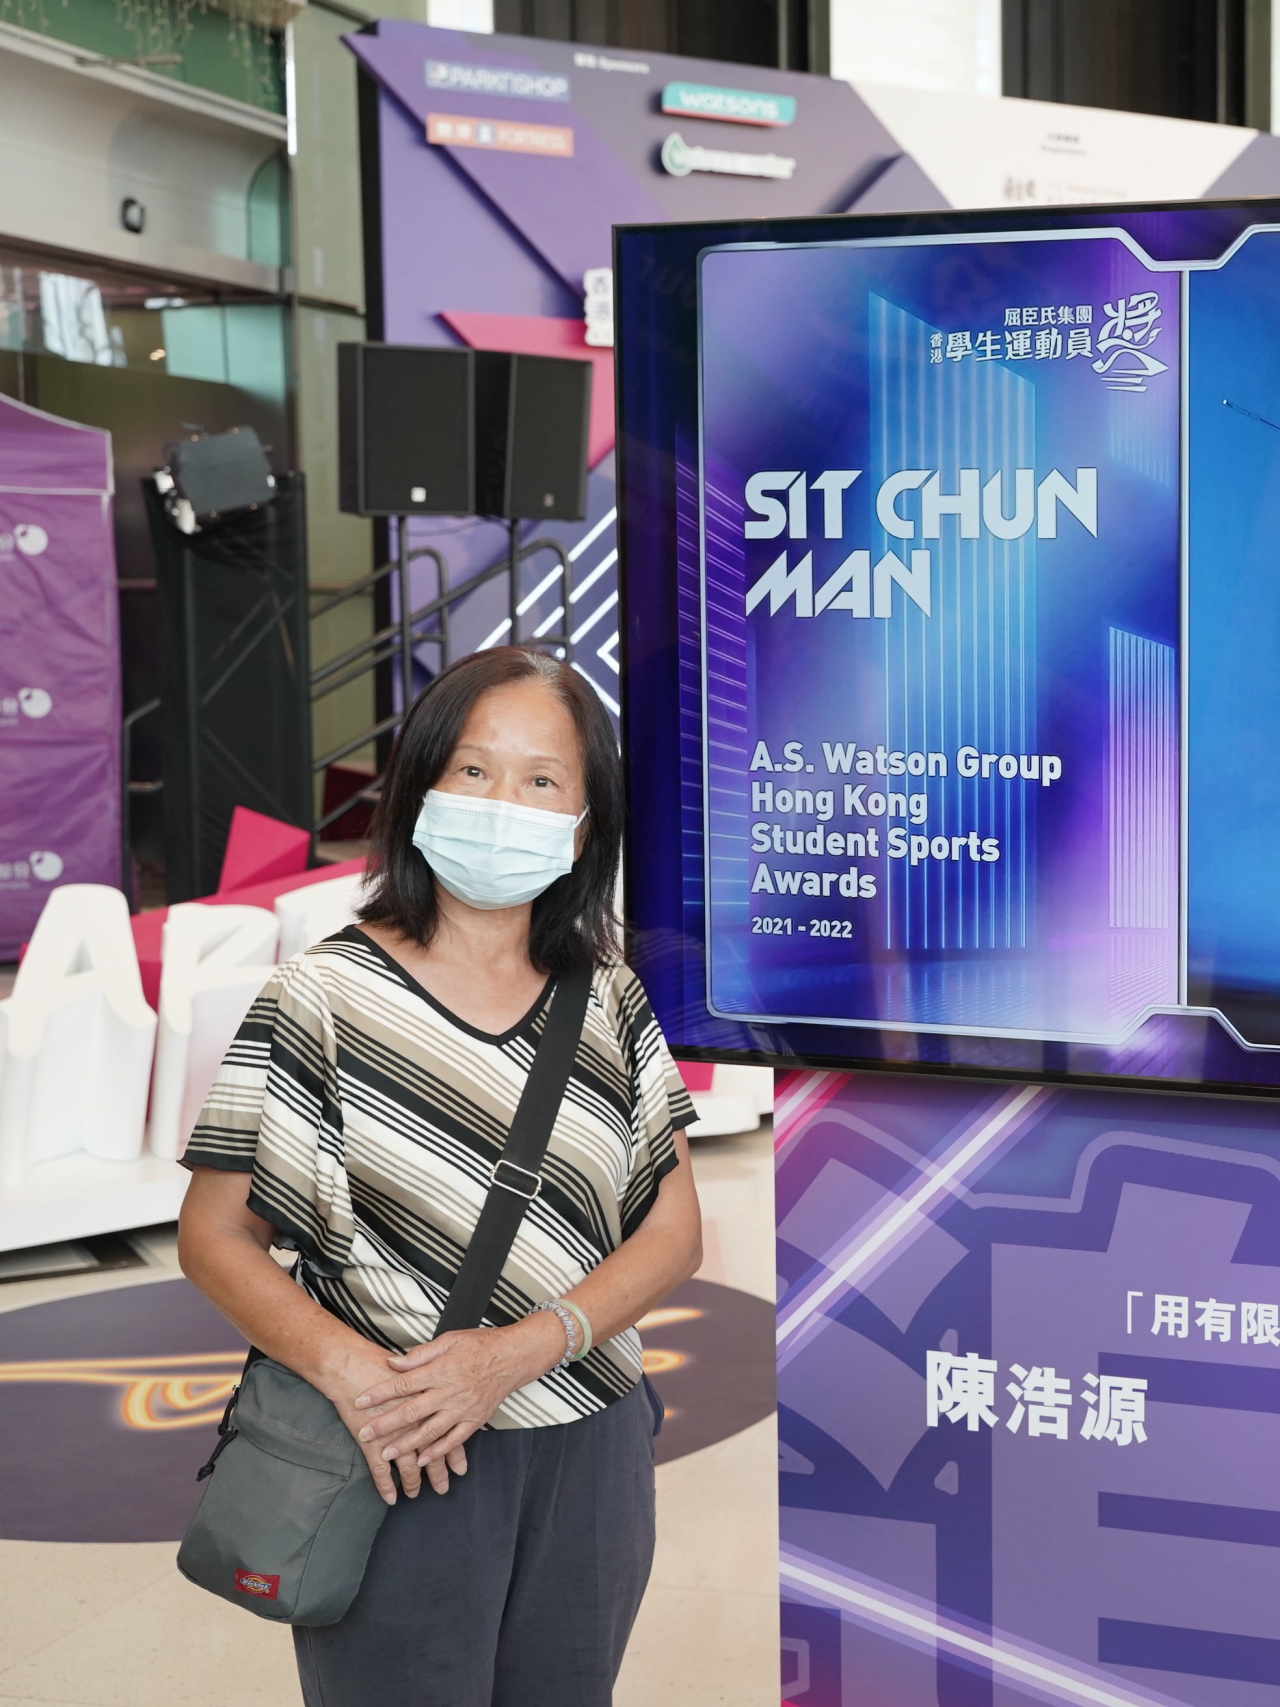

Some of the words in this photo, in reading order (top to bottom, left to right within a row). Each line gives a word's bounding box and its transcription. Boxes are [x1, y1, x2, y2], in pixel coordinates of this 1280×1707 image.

[679, 89, 779, 119] watsons
[1004, 305, 1093, 327] 屈臣氏集團
[945, 327, 1094, 363] 學生運動員
[744, 468, 863, 540] SIT
[876, 467, 1098, 540] CHUN
[745, 549, 931, 619] MAN
[750, 740, 815, 773] A.S.
[822, 742, 948, 777] Watson
[956, 746, 1063, 787] Group
[751, 781, 834, 821] Hong
[844, 784, 928, 825] Kong
[750, 822, 880, 858] Student
[886, 827, 1000, 866] Sports
[750, 862, 877, 899] Awards
[751, 917, 793, 936] 2021
[809, 918, 853, 938] 2022
[925, 1350, 1149, 1447] 陳浩源
